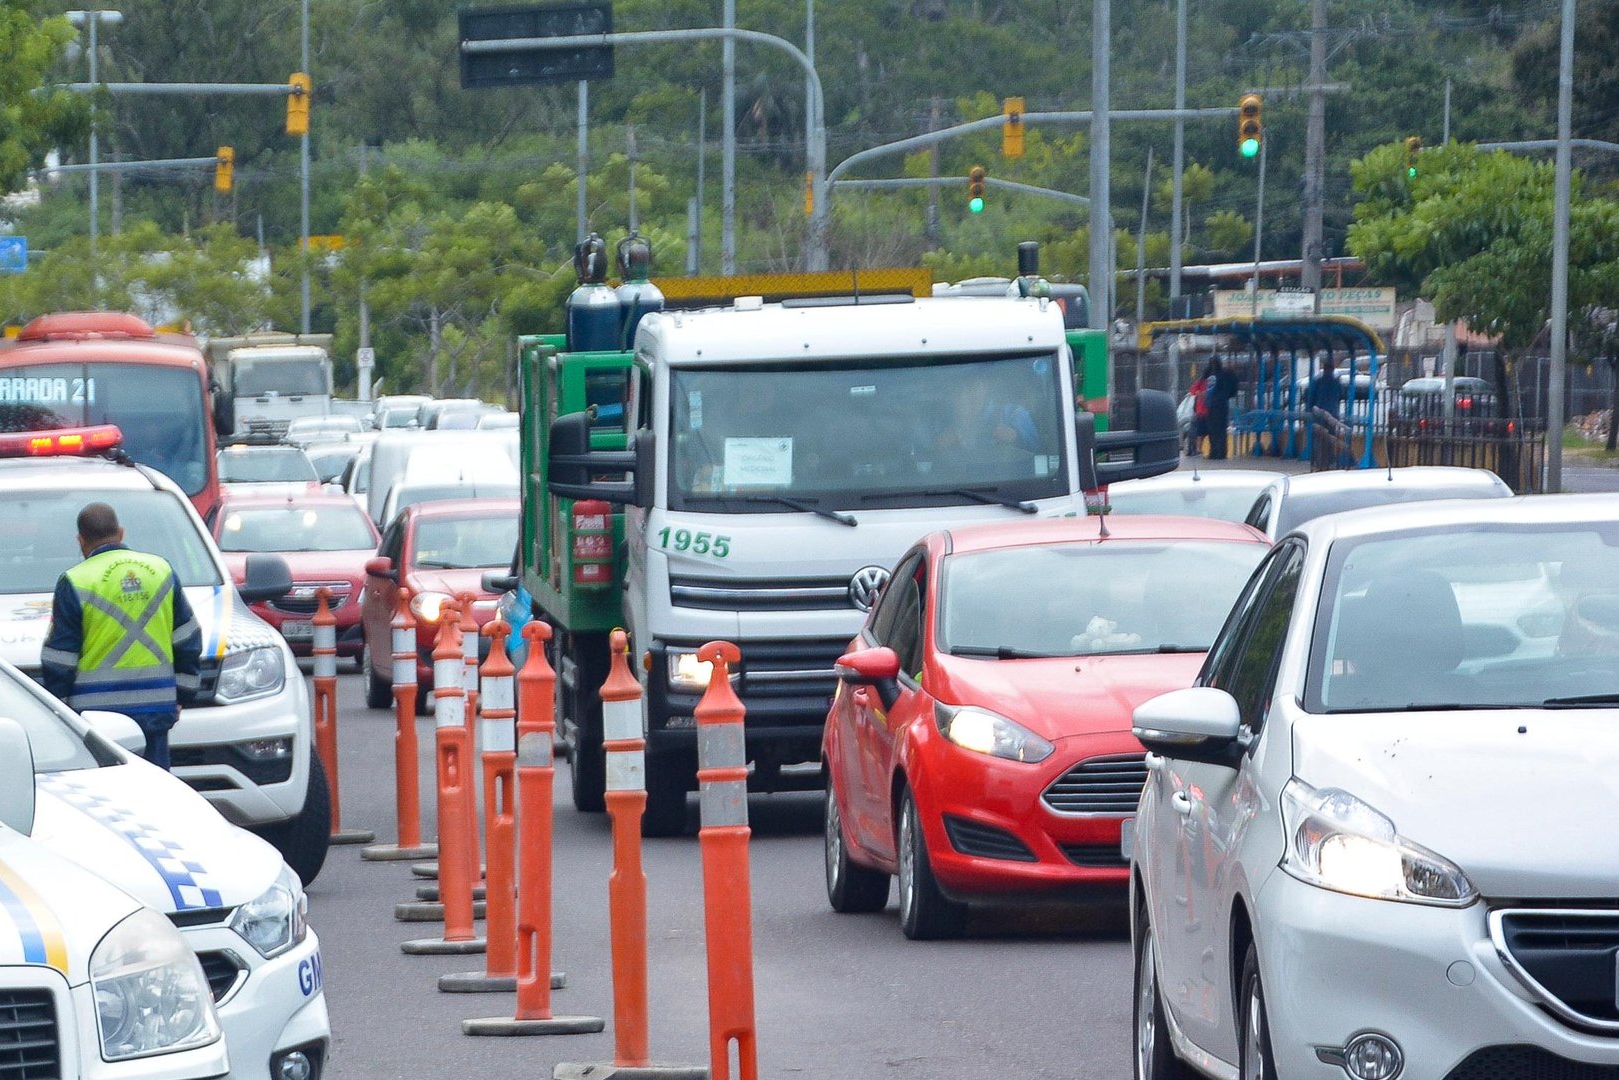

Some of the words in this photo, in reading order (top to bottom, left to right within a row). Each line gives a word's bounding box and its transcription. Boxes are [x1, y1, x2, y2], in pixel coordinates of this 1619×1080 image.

[72, 377, 96, 401] 21
[658, 526, 731, 558] 1955
[102, 559, 156, 582] FISCALIZAÇÃO
